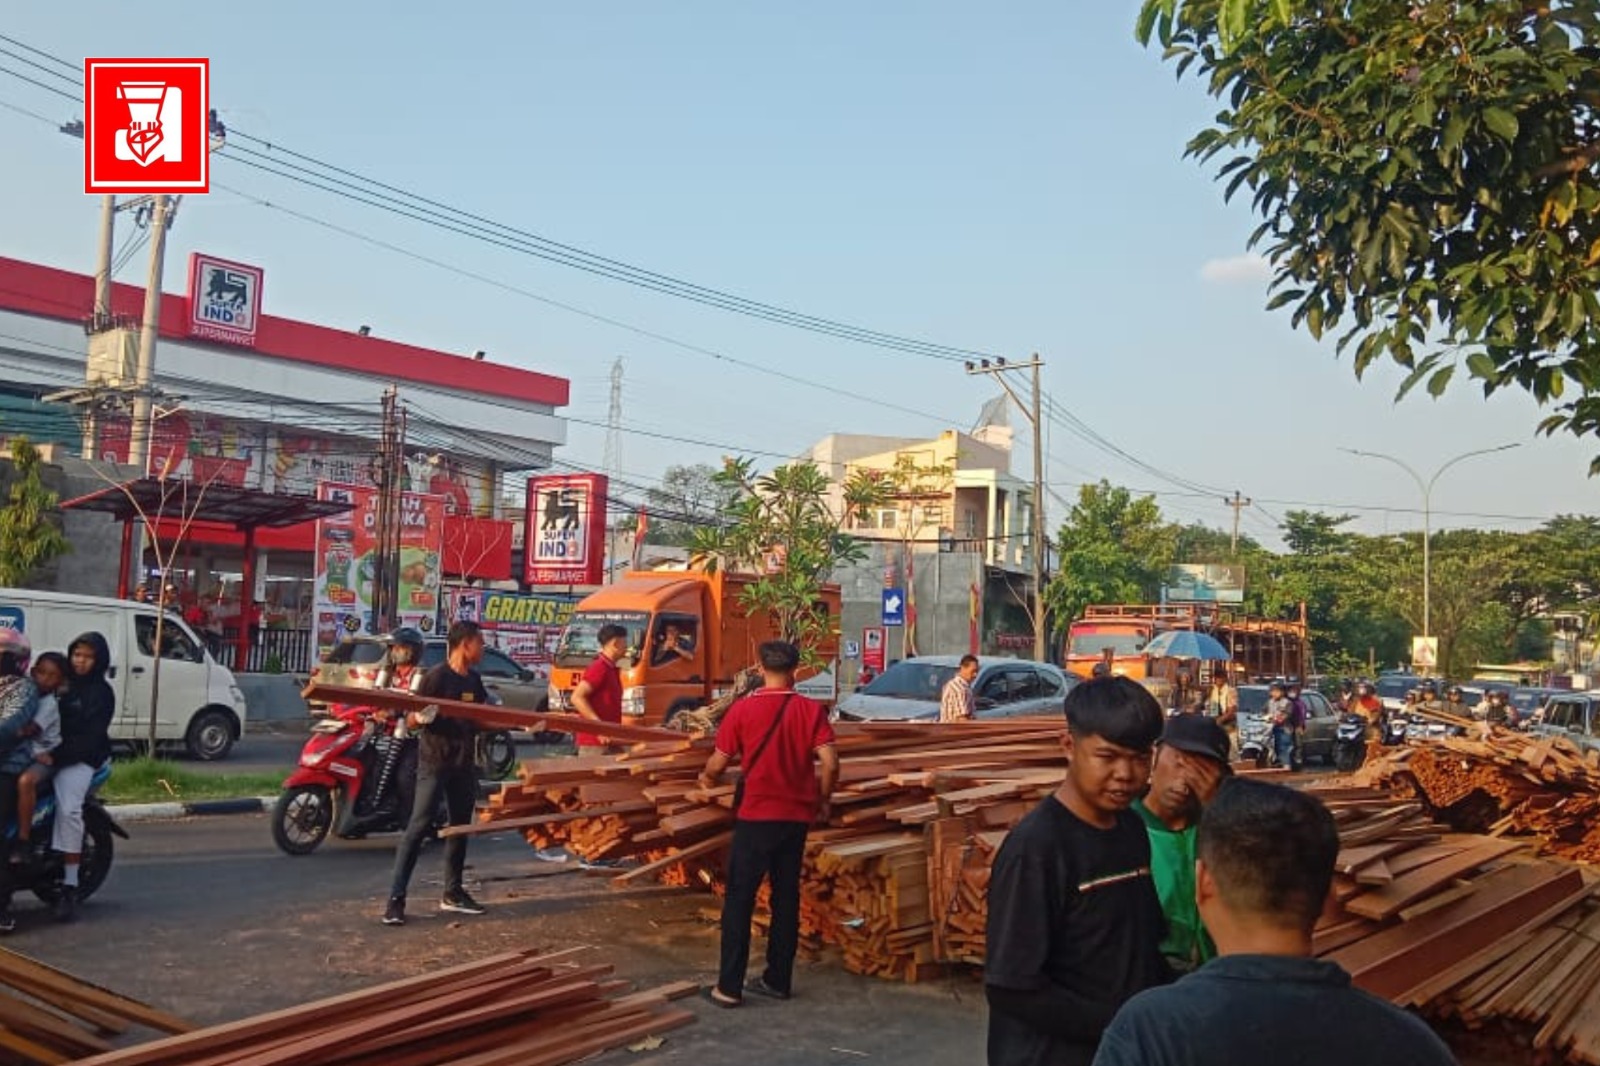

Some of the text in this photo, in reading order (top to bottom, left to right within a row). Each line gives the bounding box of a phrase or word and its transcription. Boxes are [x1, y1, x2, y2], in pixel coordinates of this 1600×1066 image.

[205, 305, 244, 324] INDO
[191, 326, 256, 346] SUPERMARKET
[544, 530, 576, 540] SUPER
[539, 541, 579, 557] INDO
[528, 569, 587, 583] SUPERMARKET
[484, 596, 556, 625] GRATIS
